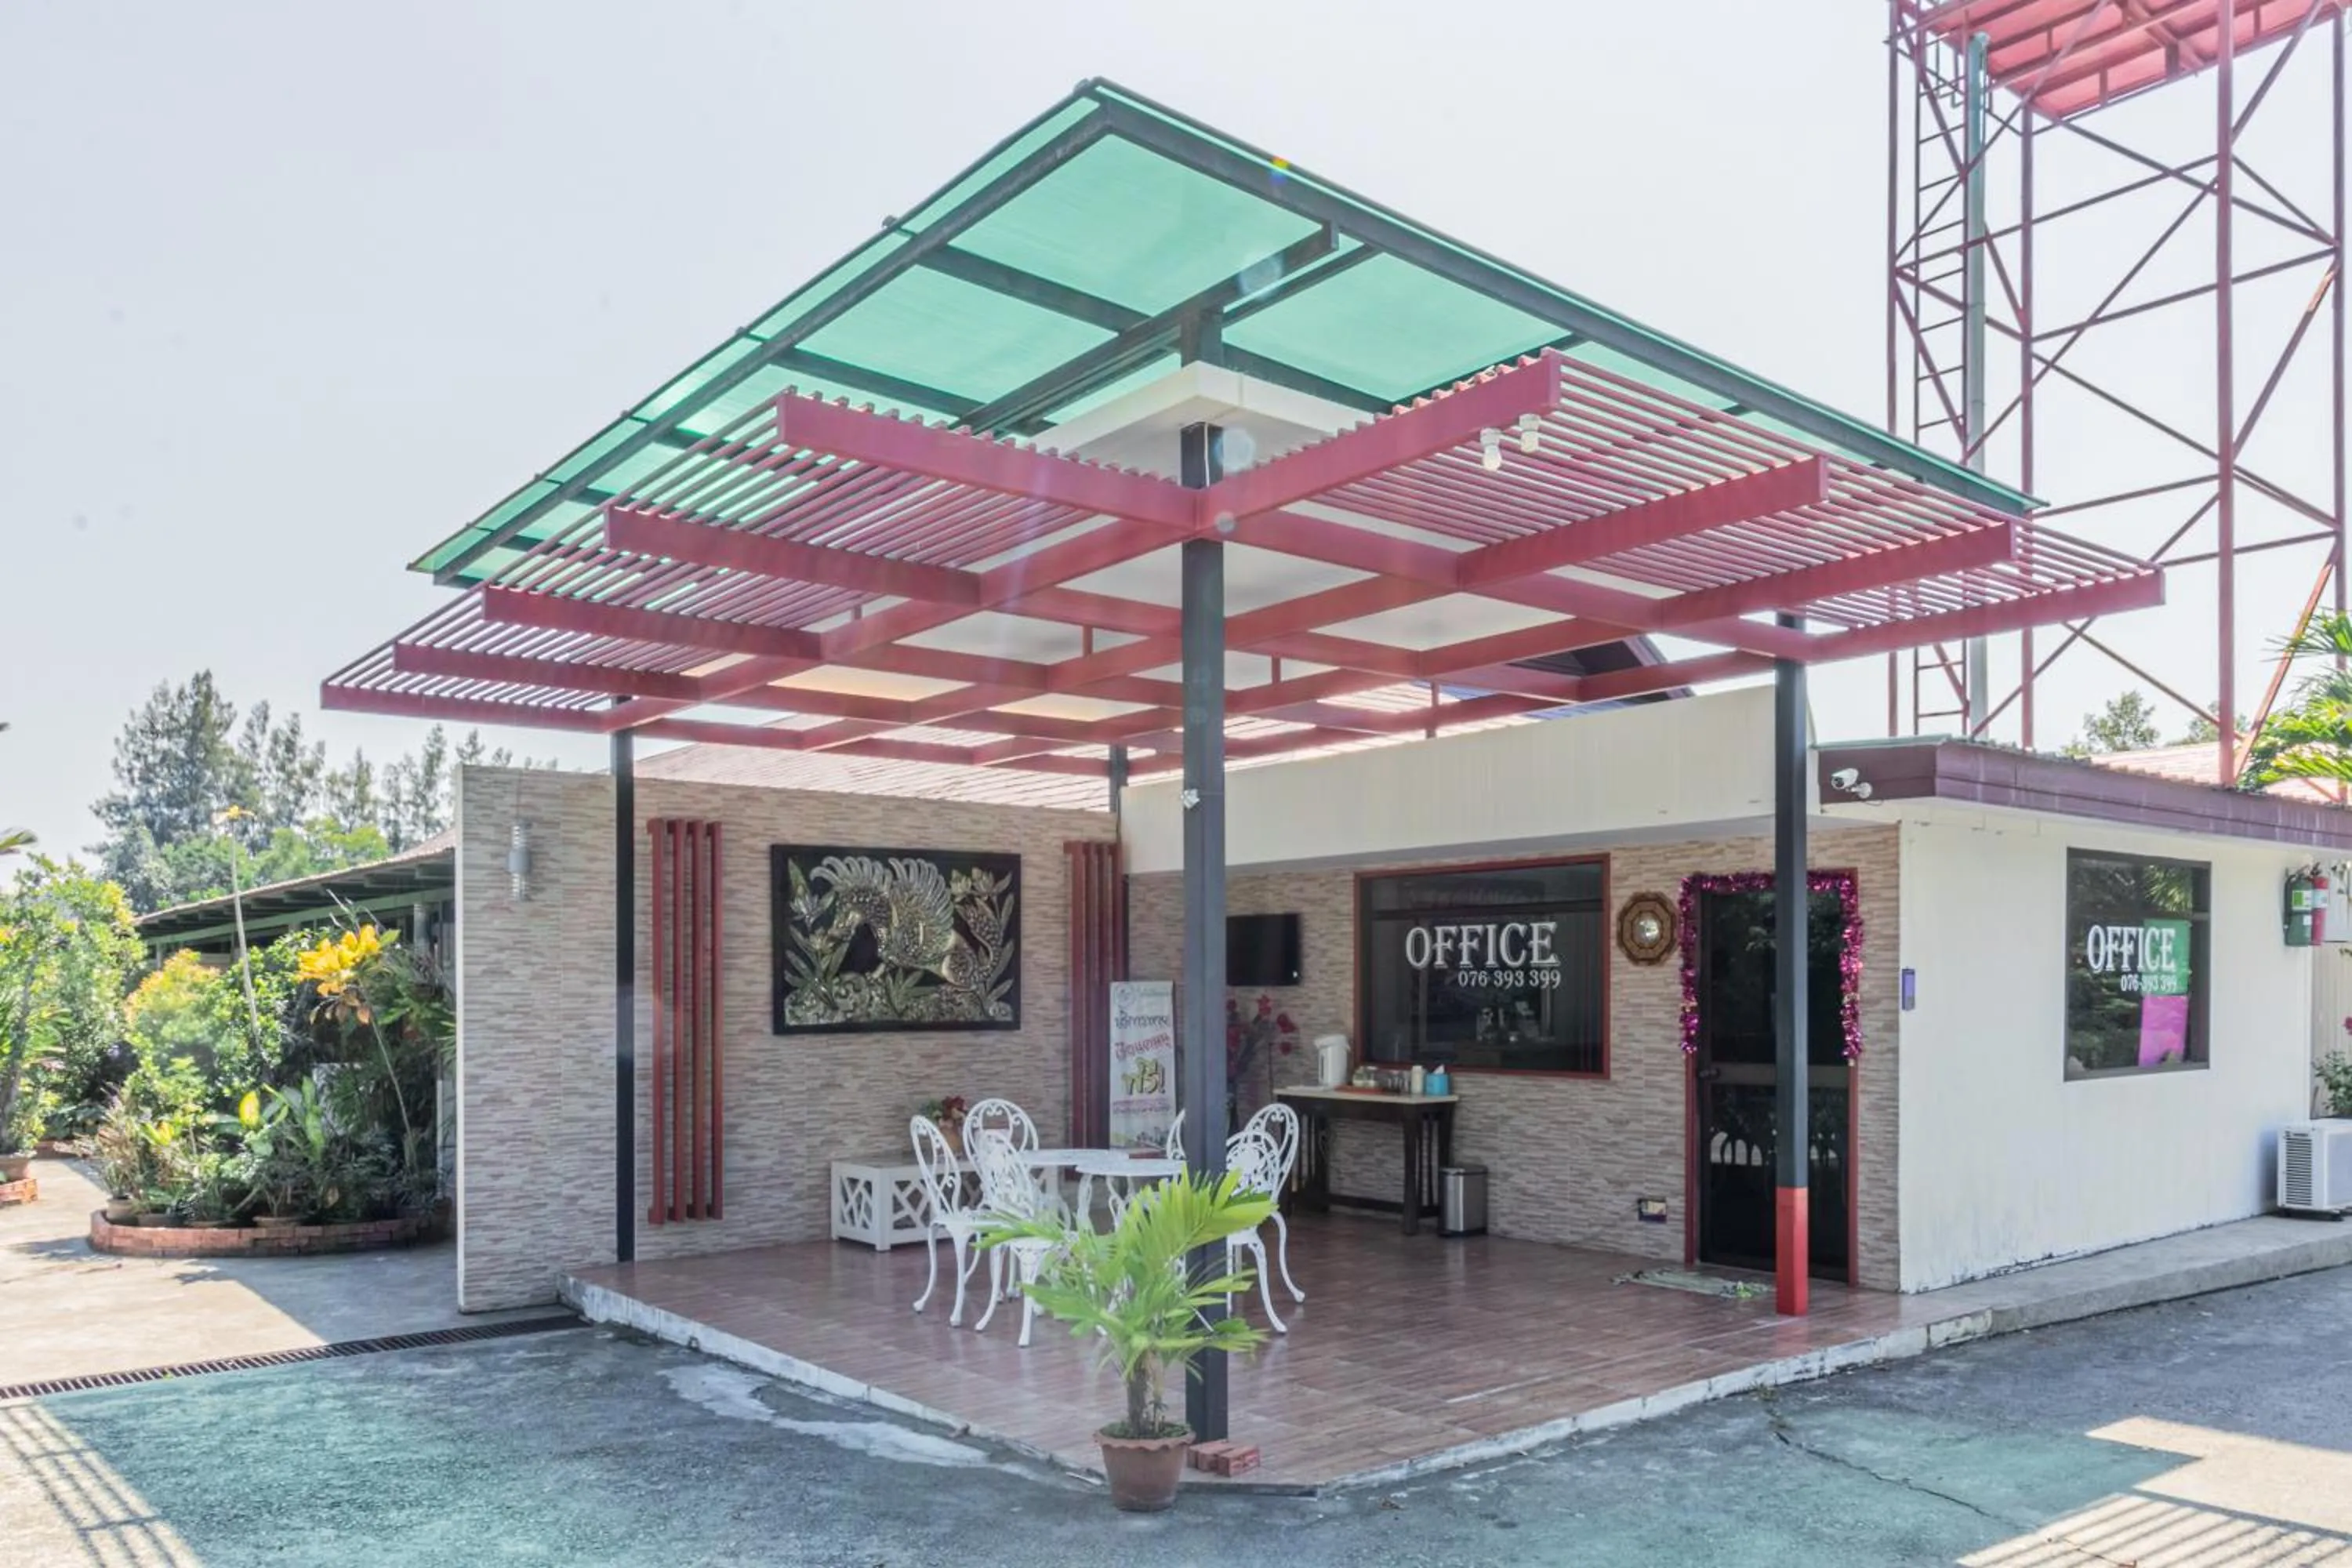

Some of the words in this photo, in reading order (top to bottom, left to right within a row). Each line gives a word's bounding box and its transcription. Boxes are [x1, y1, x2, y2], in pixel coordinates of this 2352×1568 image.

[1406, 922, 1560, 968] OFFICE
[2087, 925, 2175, 972] OFFICE
[1530, 969, 1561, 989] 399
